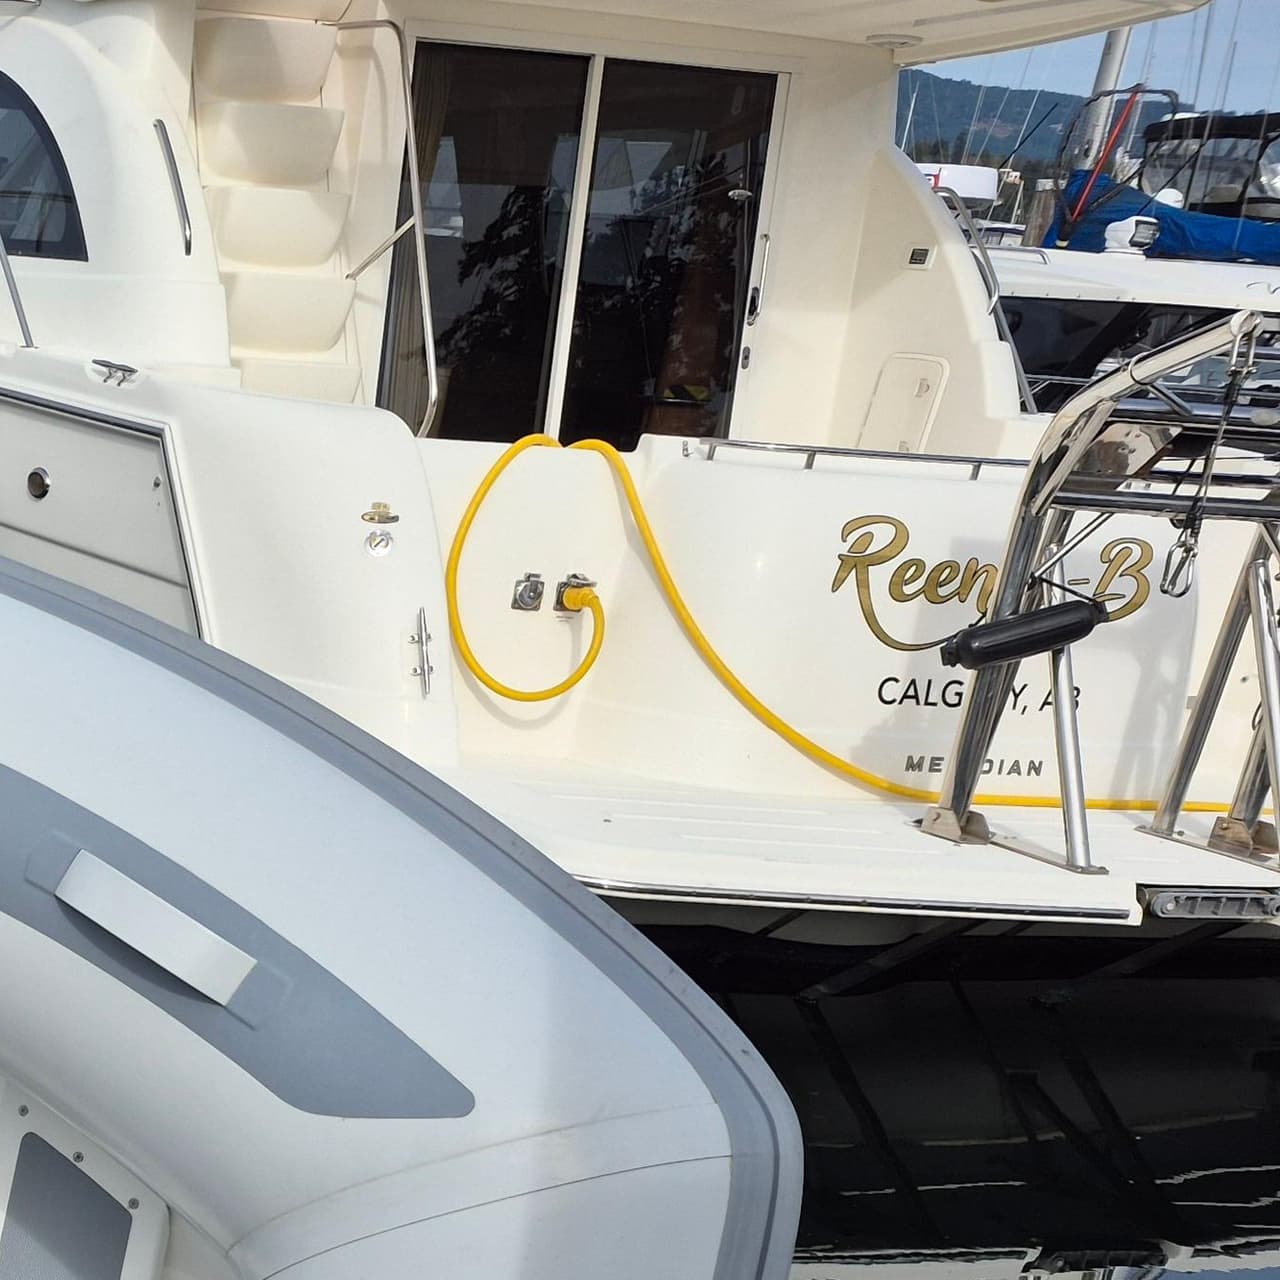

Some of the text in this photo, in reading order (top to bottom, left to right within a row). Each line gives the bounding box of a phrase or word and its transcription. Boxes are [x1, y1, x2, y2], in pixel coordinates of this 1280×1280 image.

[831, 514, 1154, 652] Reen-B
[877, 676, 1028, 715] CALGY,
[904, 755, 1043, 777] MEDIAN
